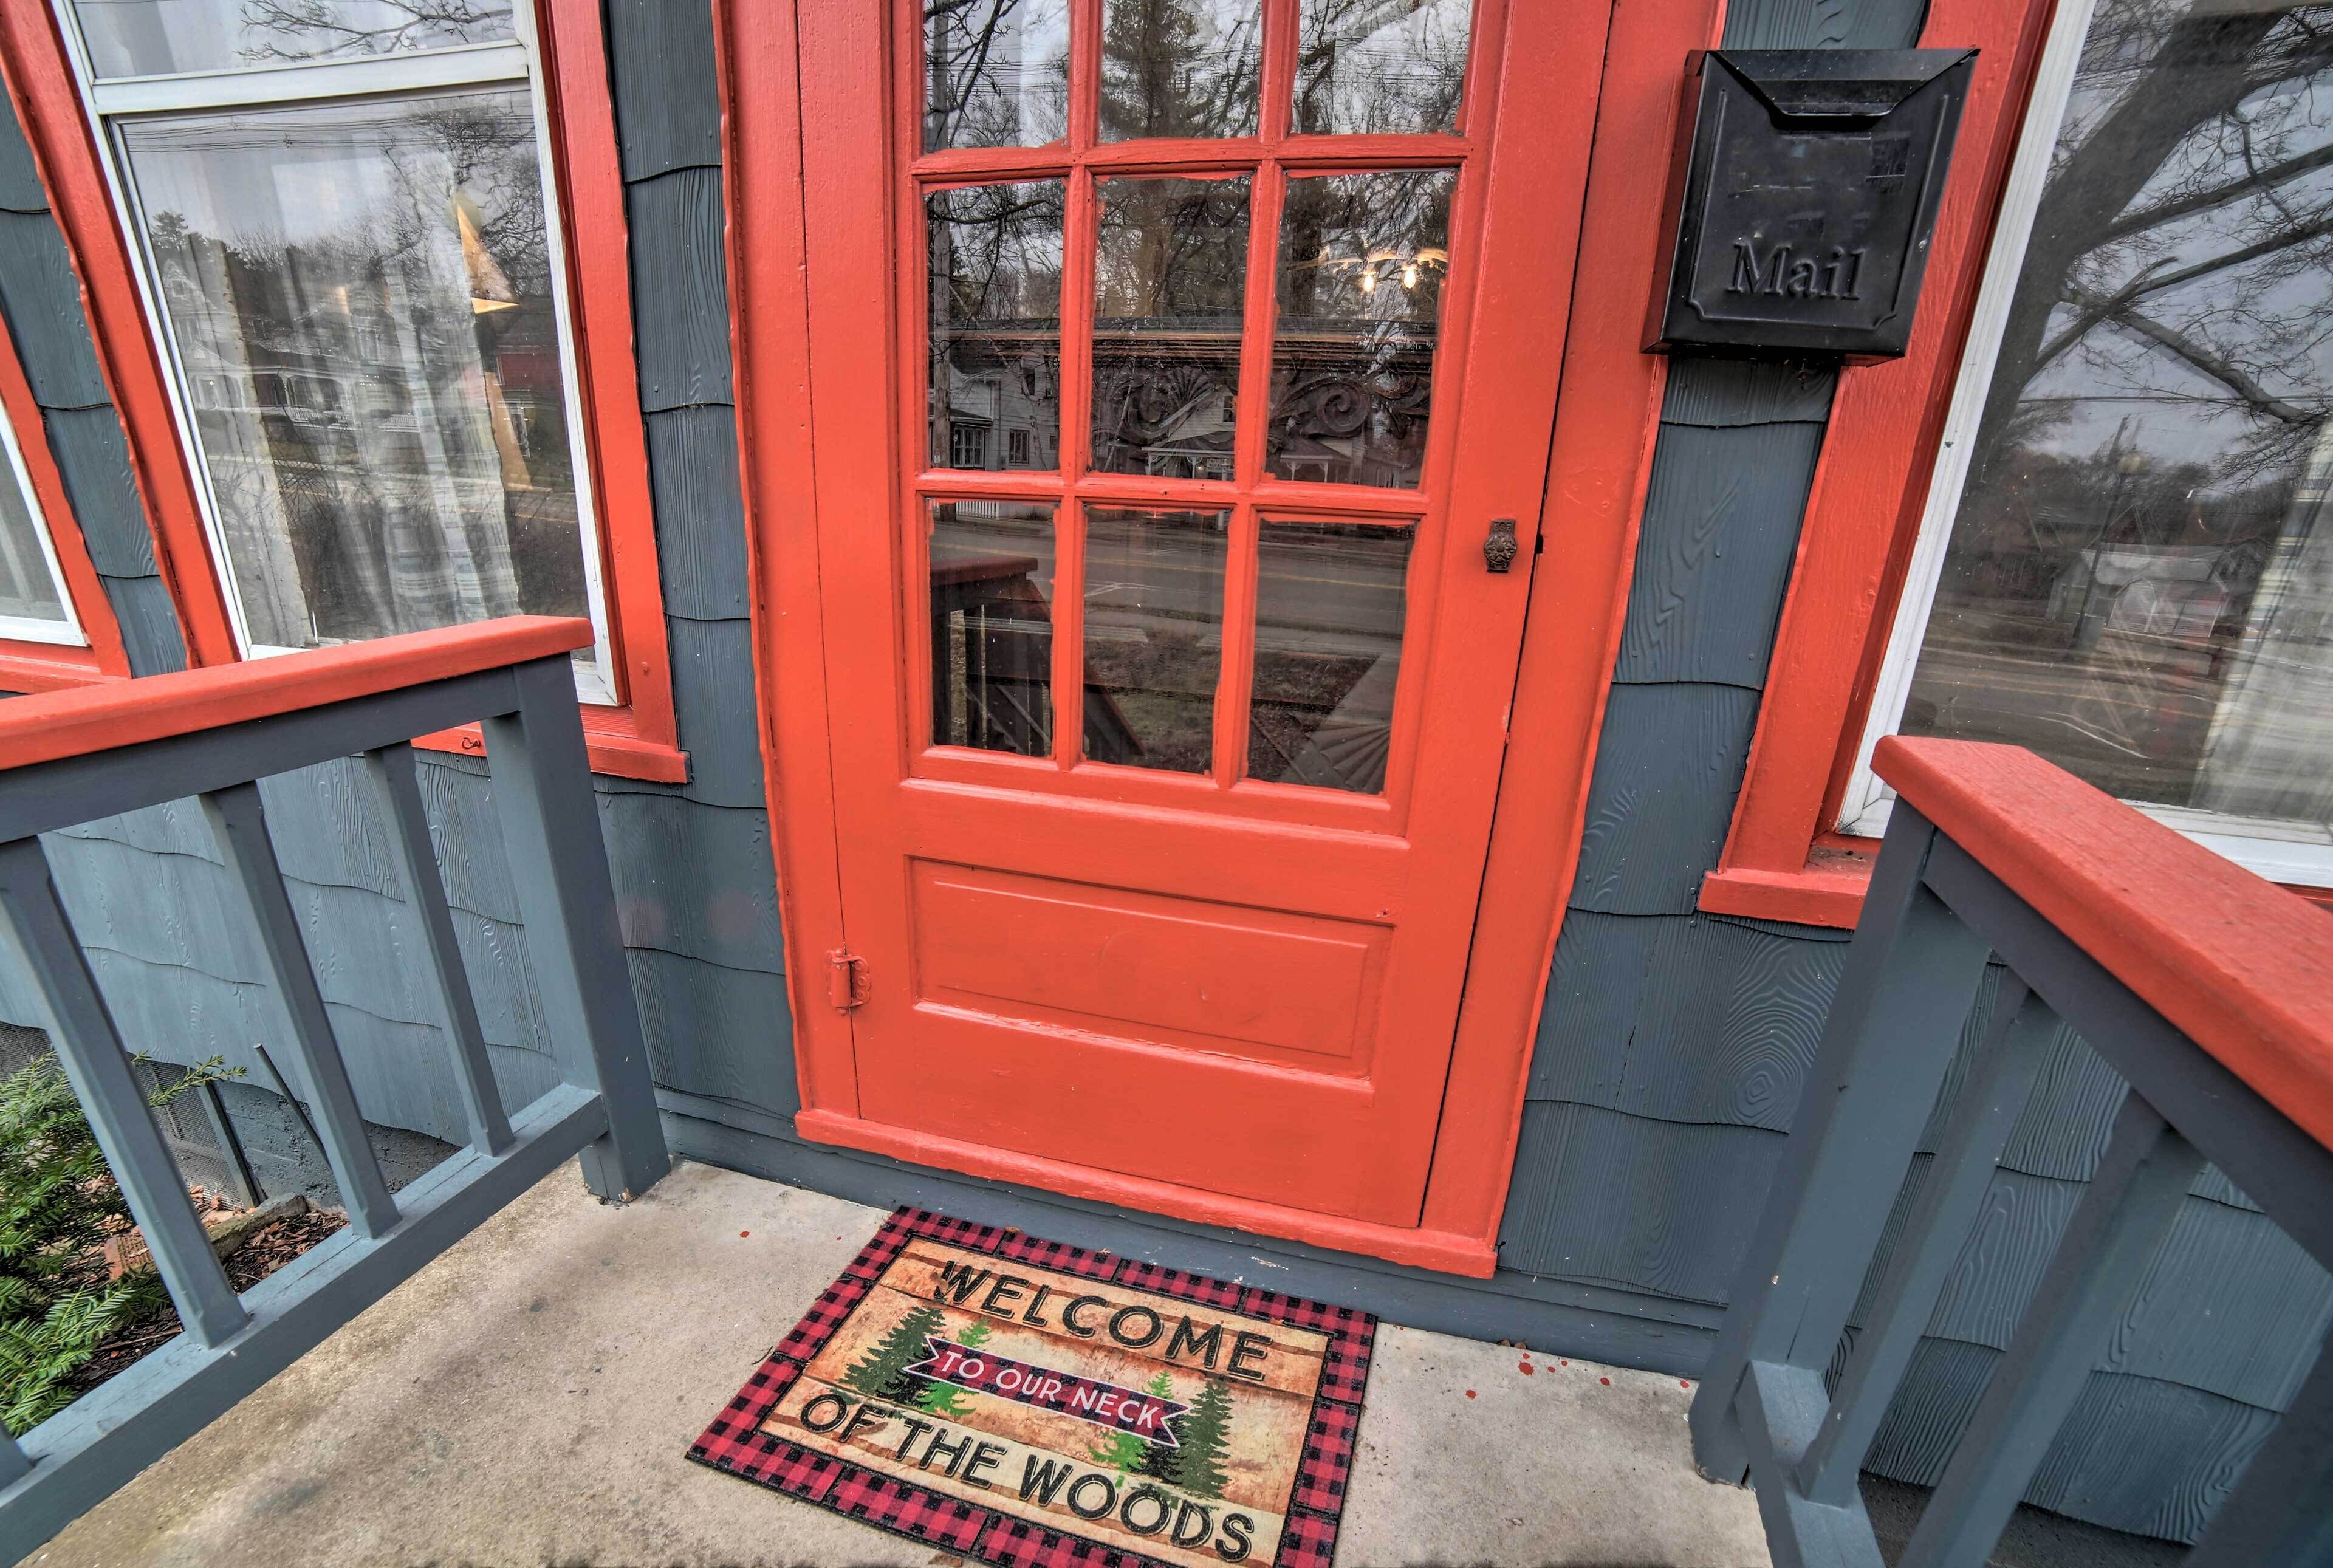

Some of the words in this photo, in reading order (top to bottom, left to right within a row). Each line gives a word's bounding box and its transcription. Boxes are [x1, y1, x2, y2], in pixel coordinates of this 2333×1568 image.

[1726, 241, 1866, 300] Mail
[934, 1260, 1273, 1381] WELCOME
[941, 1351, 984, 1378] TO
[996, 1369, 1061, 1402] OUR
[1071, 1386, 1159, 1428] NECK
[800, 1394, 886, 1443] OF
[894, 1417, 1007, 1489] THE
[1019, 1454, 1254, 1563] WOODS
